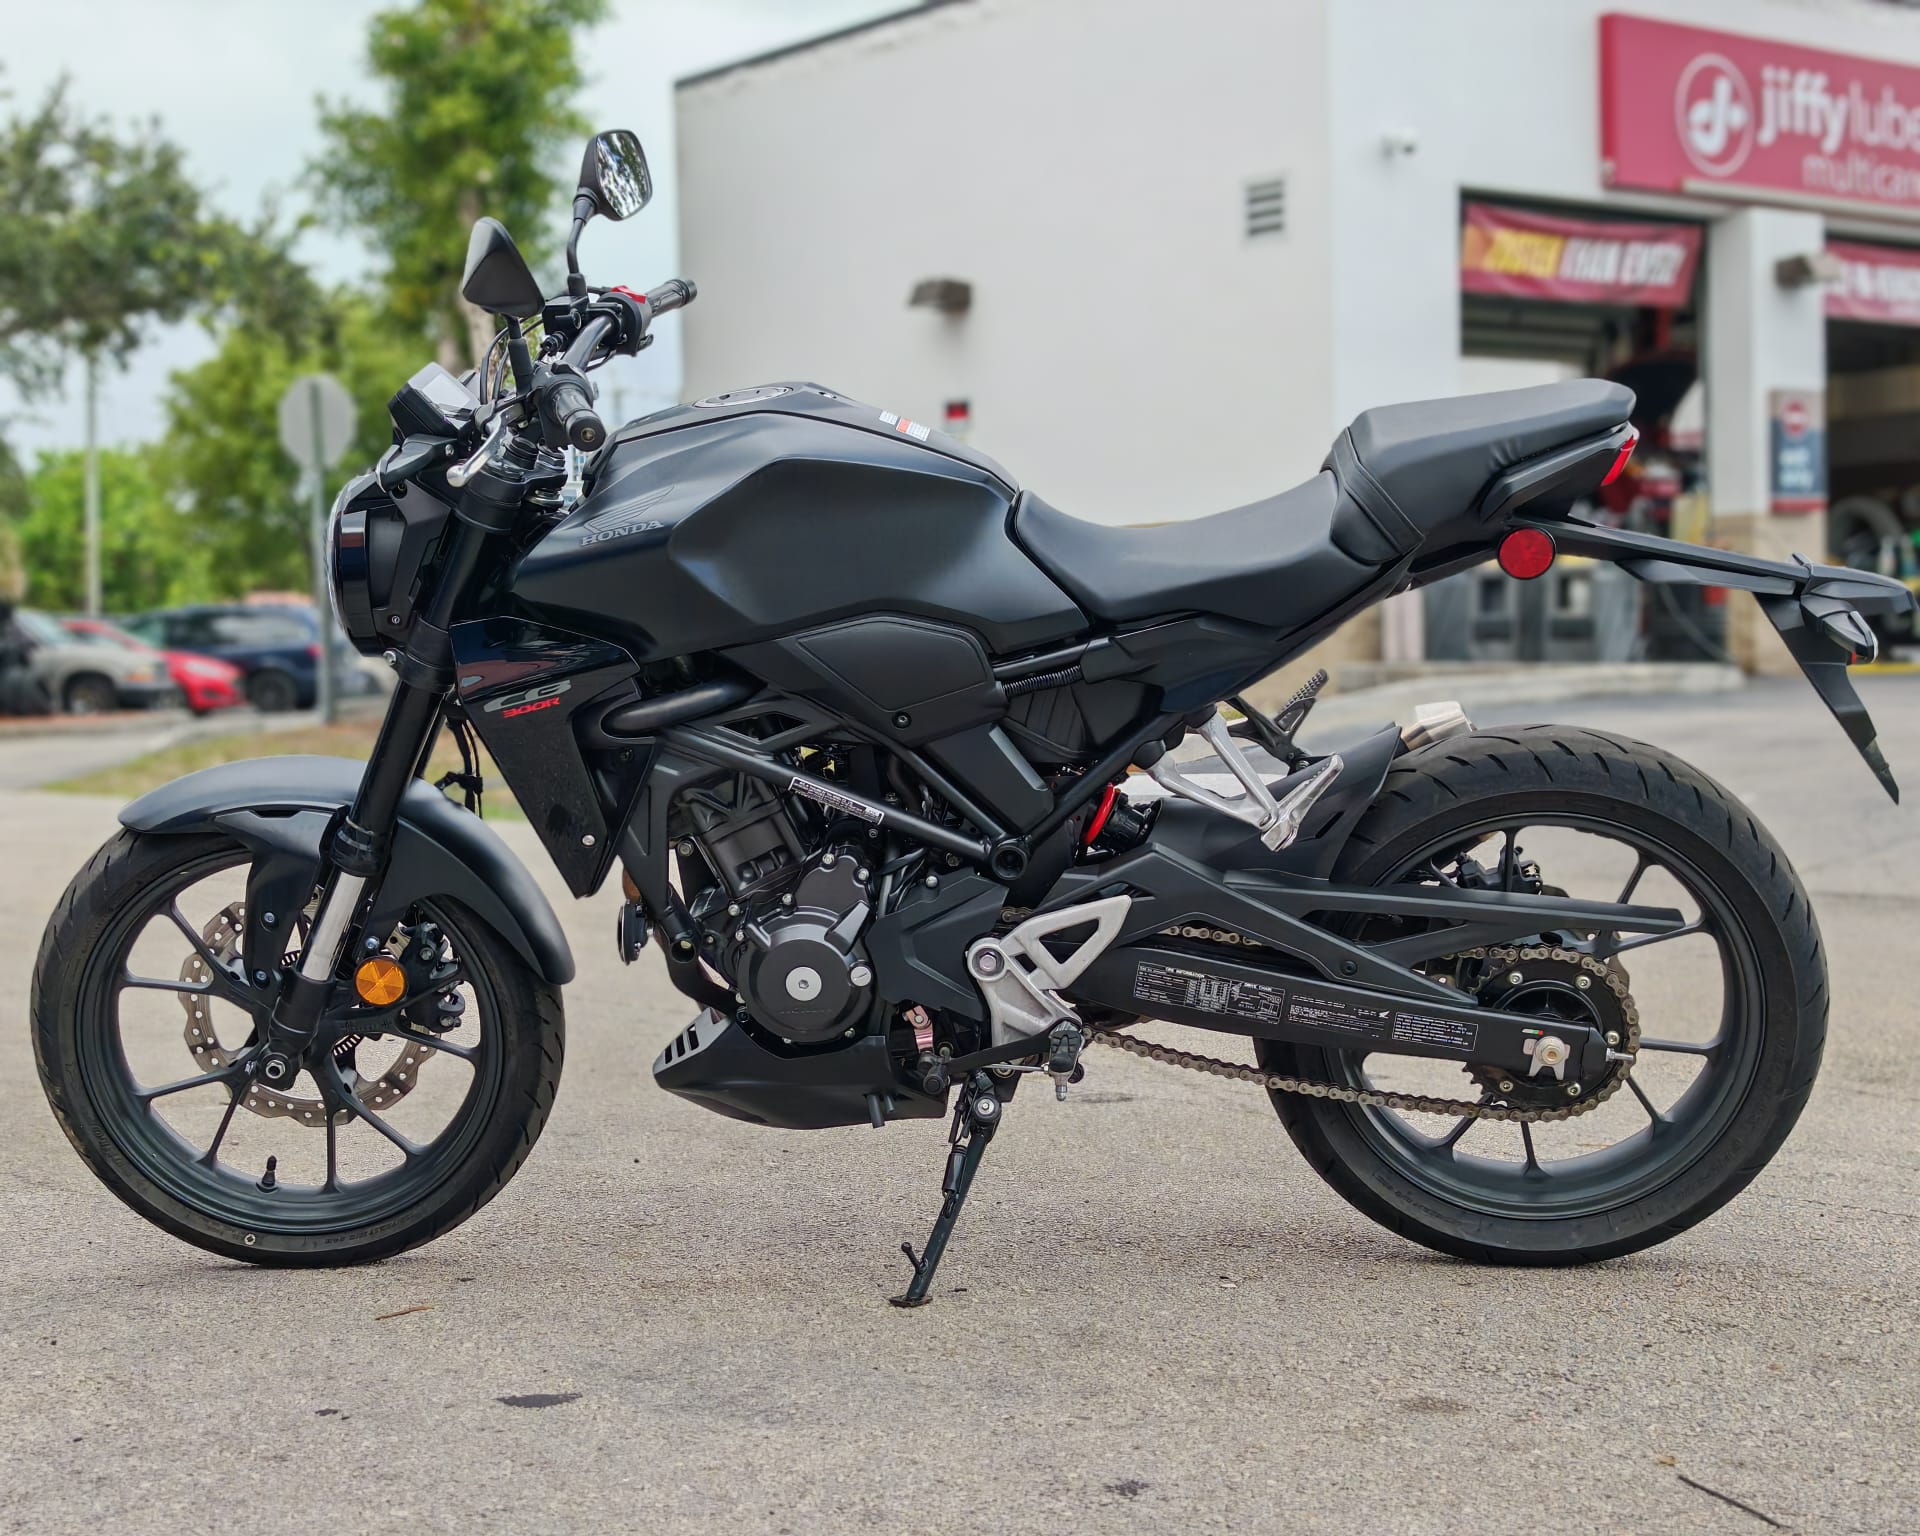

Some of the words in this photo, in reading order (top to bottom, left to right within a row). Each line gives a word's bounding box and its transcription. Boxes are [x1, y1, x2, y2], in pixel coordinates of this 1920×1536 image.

[1758, 65, 1847, 154] jiffy
[581, 520, 664, 546] HONDA
[483, 680, 572, 713] CB
[502, 697, 560, 718] 300R
